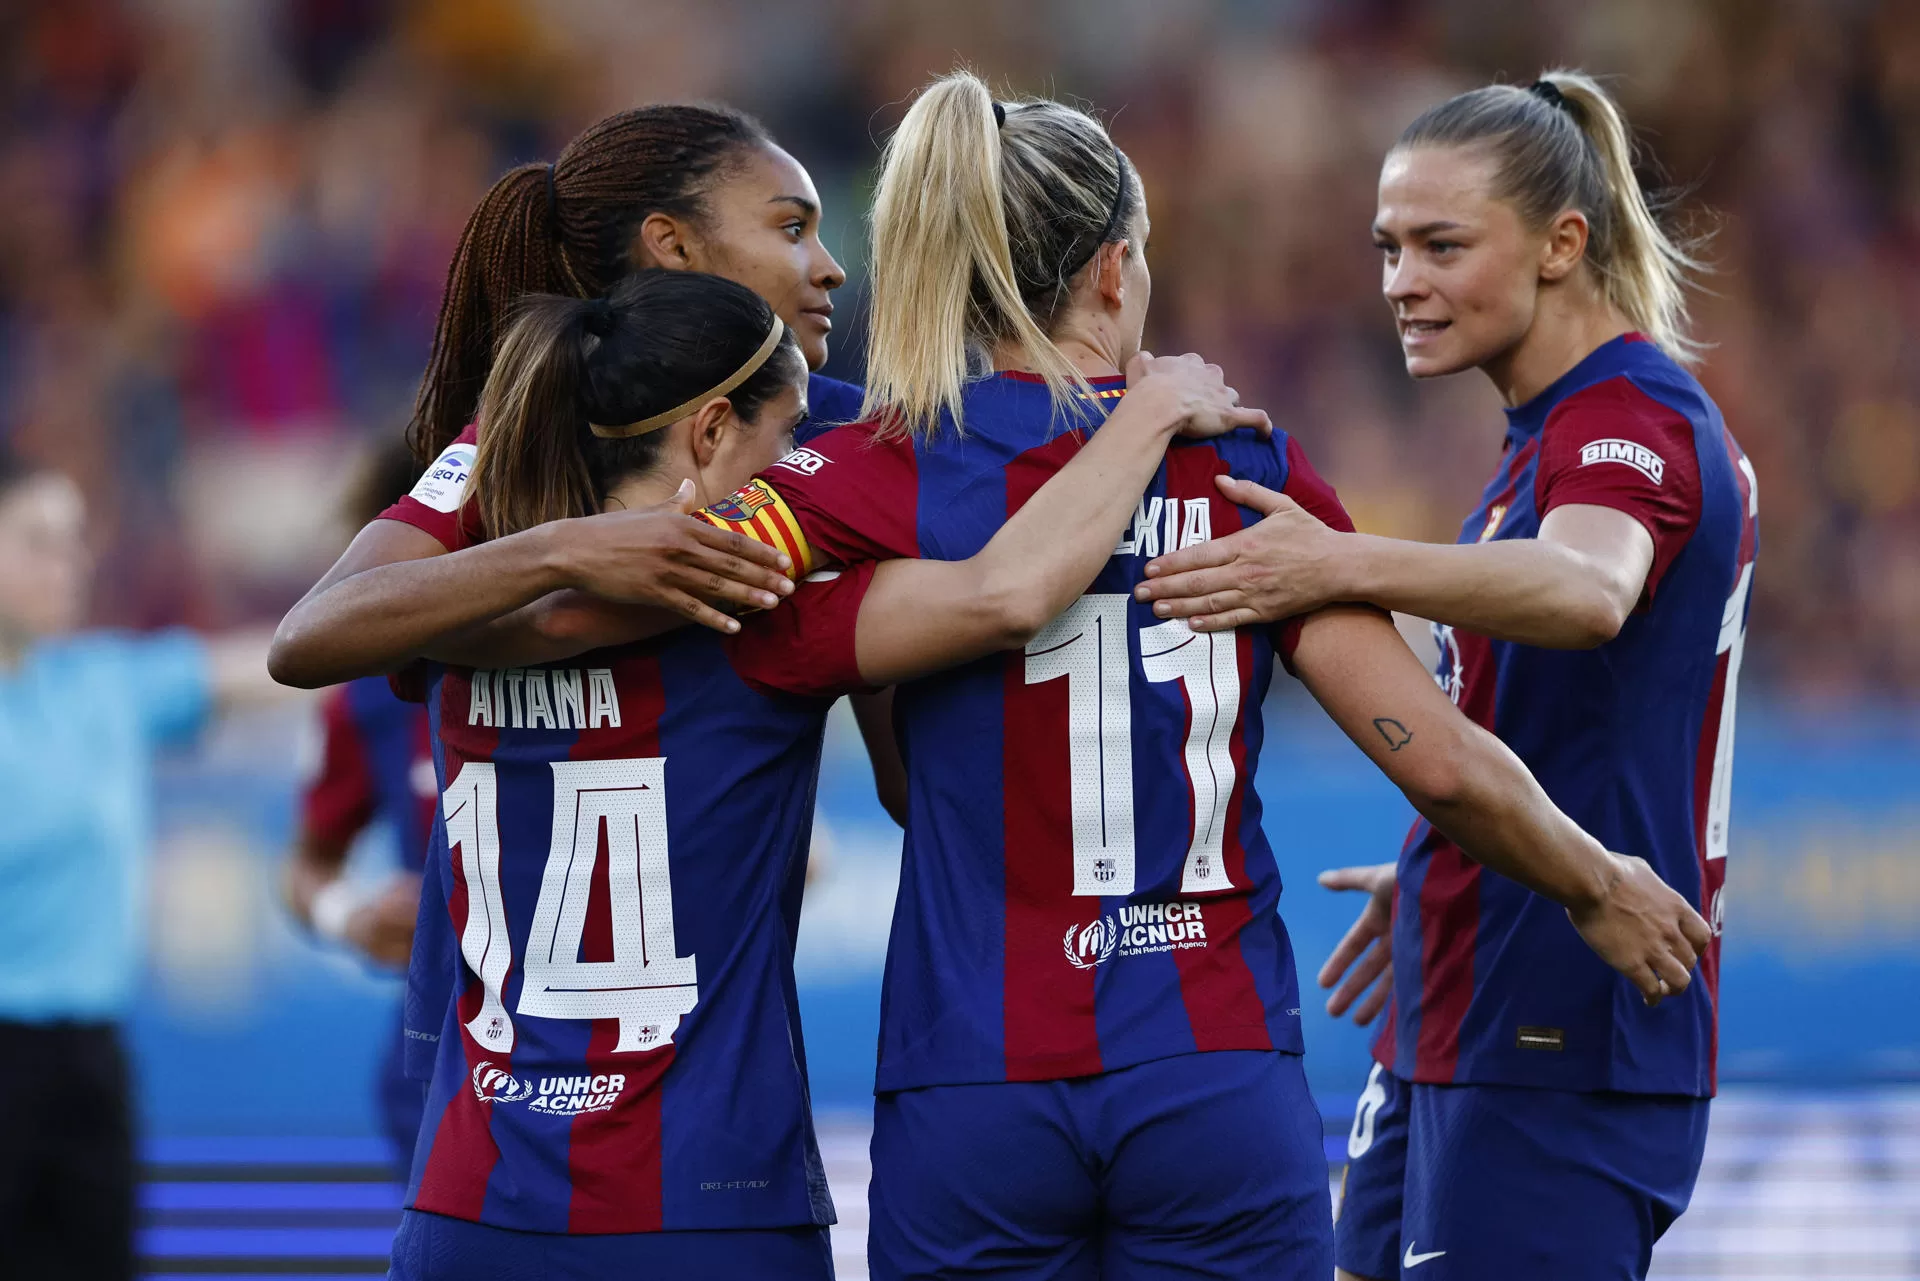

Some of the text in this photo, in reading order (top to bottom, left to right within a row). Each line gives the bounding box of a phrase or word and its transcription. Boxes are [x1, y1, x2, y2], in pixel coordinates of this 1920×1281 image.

[1581, 442, 1664, 482] BIMBO
[467, 668, 622, 729] AITANA
[1025, 593, 1240, 896] 11
[442, 756, 699, 1054] 14
[1118, 902, 1203, 928] UNHCR
[1119, 921, 1207, 949] ACNUR
[1118, 941, 1208, 957] The UN Refugee Agency
[538, 1074, 626, 1096] UNHCR
[528, 1092, 620, 1111] ACNUR
[528, 1105, 542, 1113] The
[585, 1104, 613, 1113] Agency
